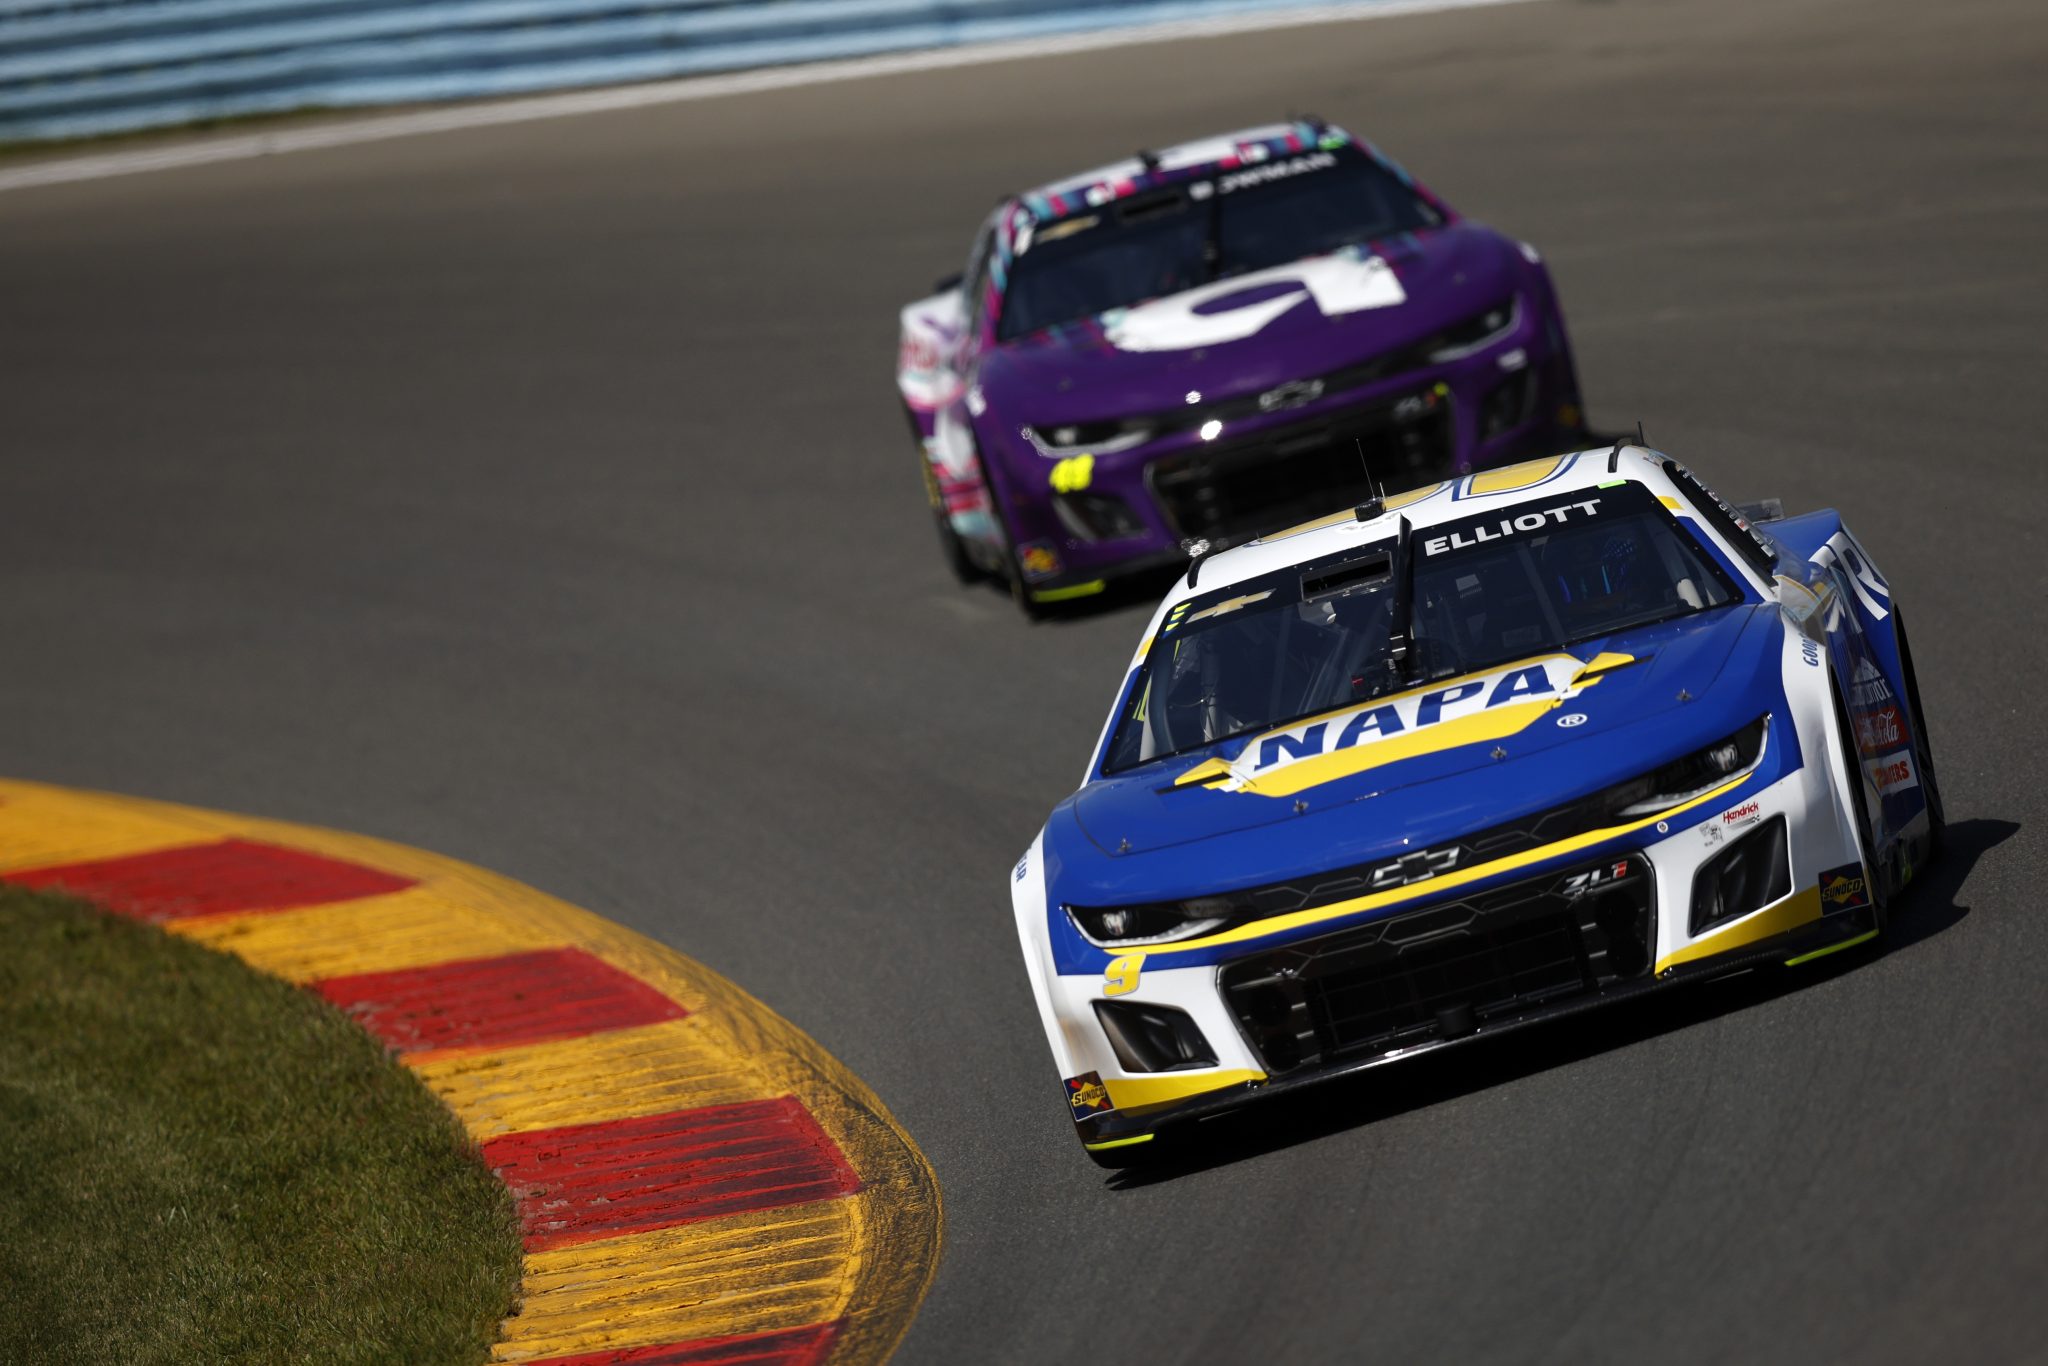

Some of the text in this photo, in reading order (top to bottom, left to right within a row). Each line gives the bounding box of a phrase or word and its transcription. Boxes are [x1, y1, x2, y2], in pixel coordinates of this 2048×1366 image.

[1424, 498, 1601, 557] ELLIOTT
[1253, 664, 1555, 772] NAPA
[1723, 802, 1759, 825] Hendrick
[1562, 861, 1628, 895] ZL1
[1822, 879, 1863, 902] SUNOCO
[1103, 952, 1147, 997] 9
[1073, 1085, 1105, 1105] SUNOCO
